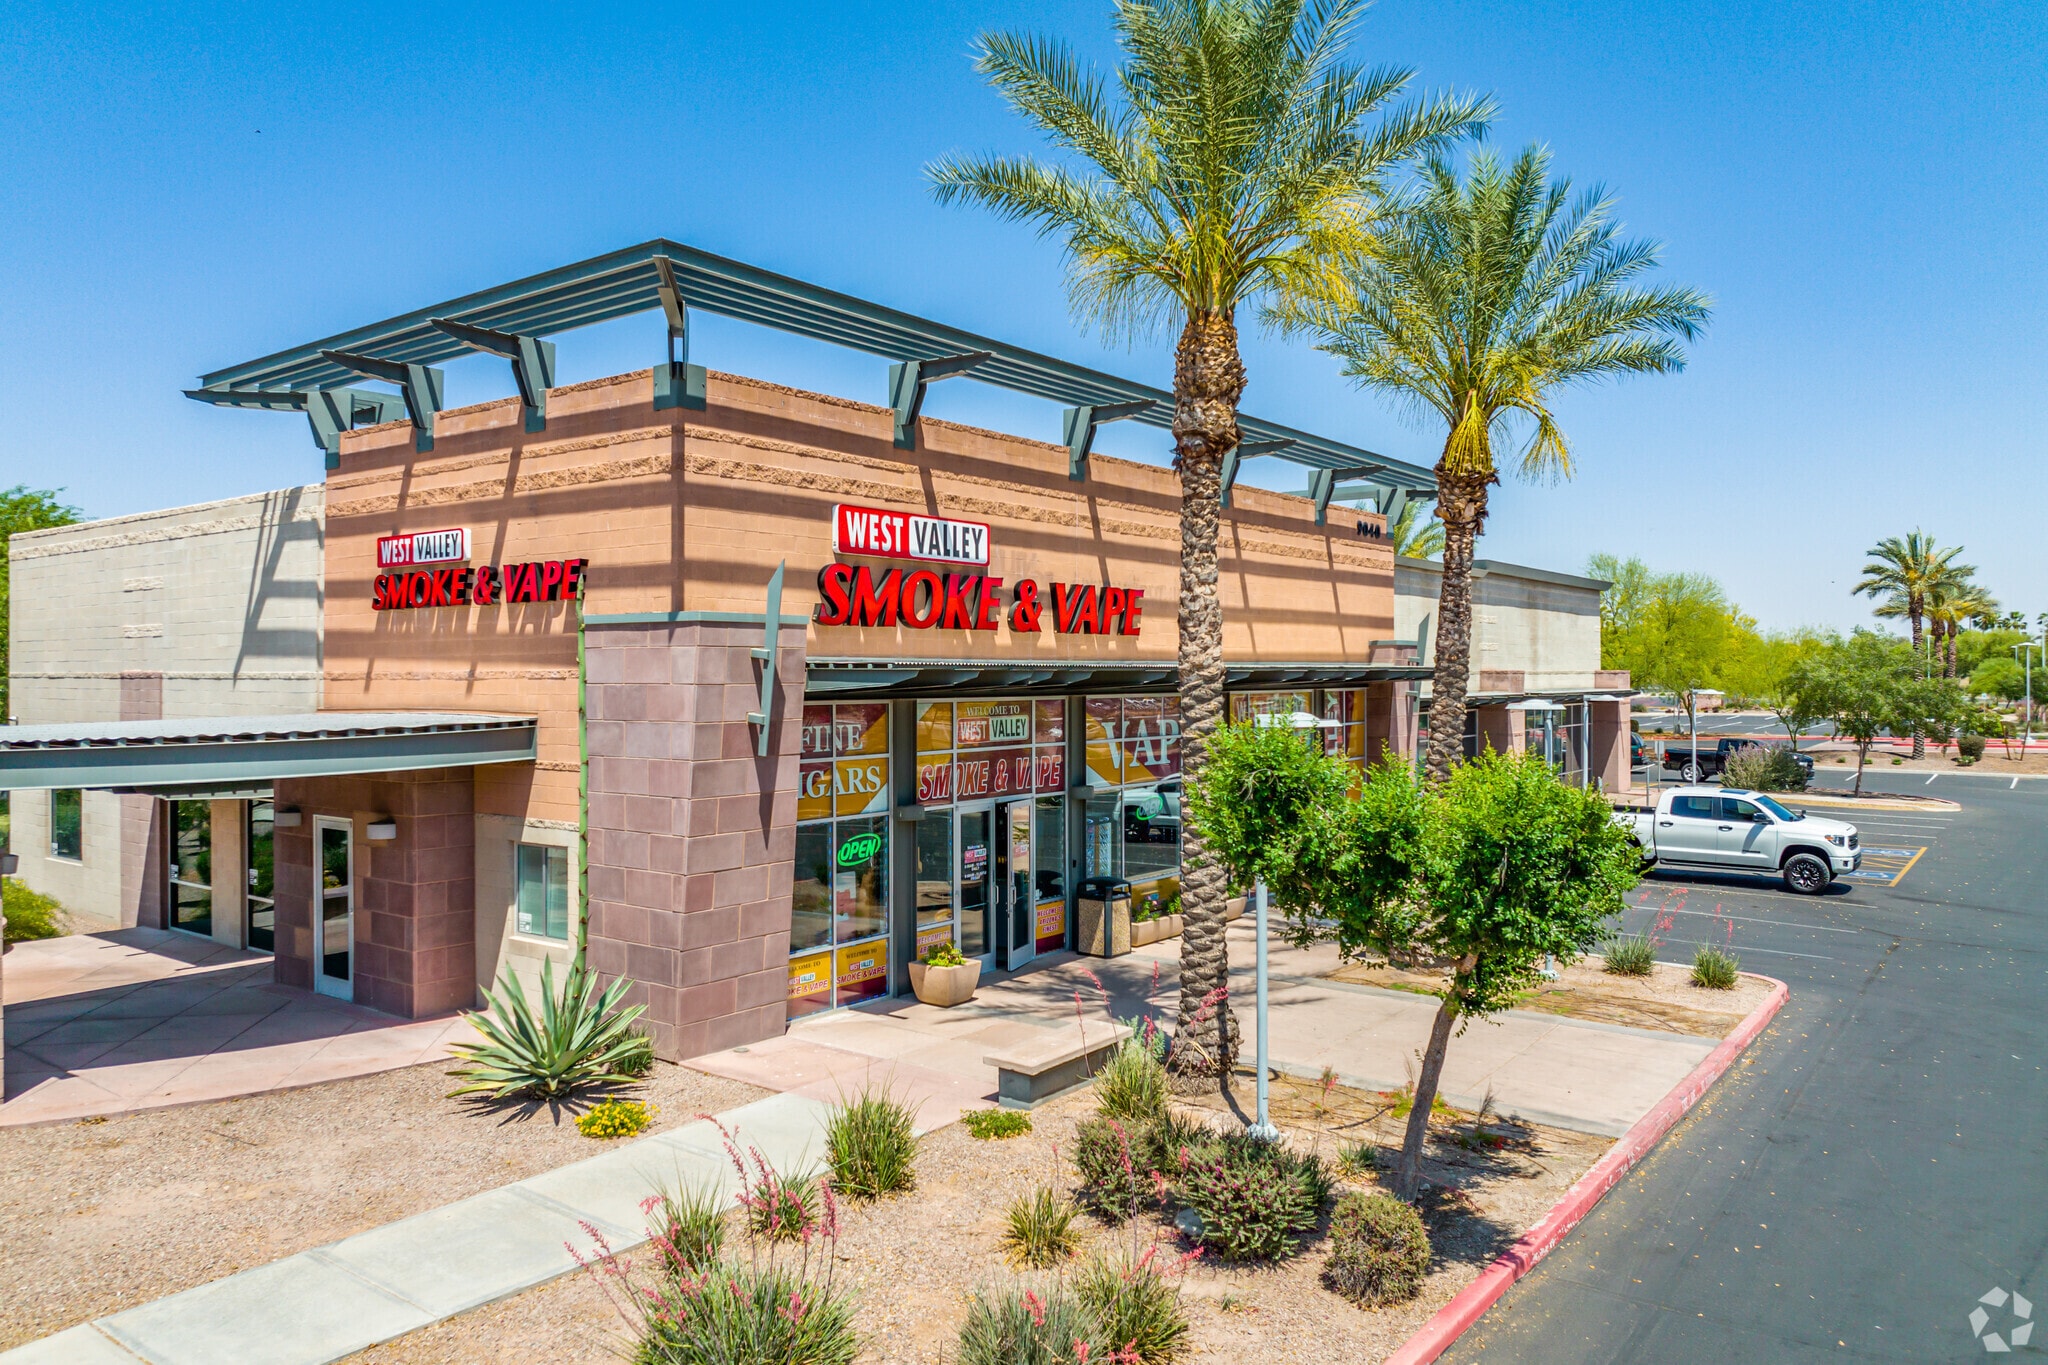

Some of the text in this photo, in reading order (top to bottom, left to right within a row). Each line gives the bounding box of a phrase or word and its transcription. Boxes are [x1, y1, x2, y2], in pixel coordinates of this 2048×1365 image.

[380, 532, 459, 564] WEST VALLEY
[845, 510, 983, 561] WEST VALLEY
[372, 559, 585, 611] SMOKE & VAPE
[813, 562, 1145, 636] SMOKE & VAPE
[966, 705, 1020, 717] WELCOME TO
[800, 724, 863, 753] FINE
[960, 718, 1027, 740] WEST VALLEY
[1101, 719, 1180, 769] VAP
[798, 765, 881, 799] IGARS
[919, 755, 1062, 800] SMOKE & VAPE
[840, 839, 877, 861] OPEN
[810, 979, 829, 991] VAPE
[836, 965, 886, 984] SMOKE & VAPE
